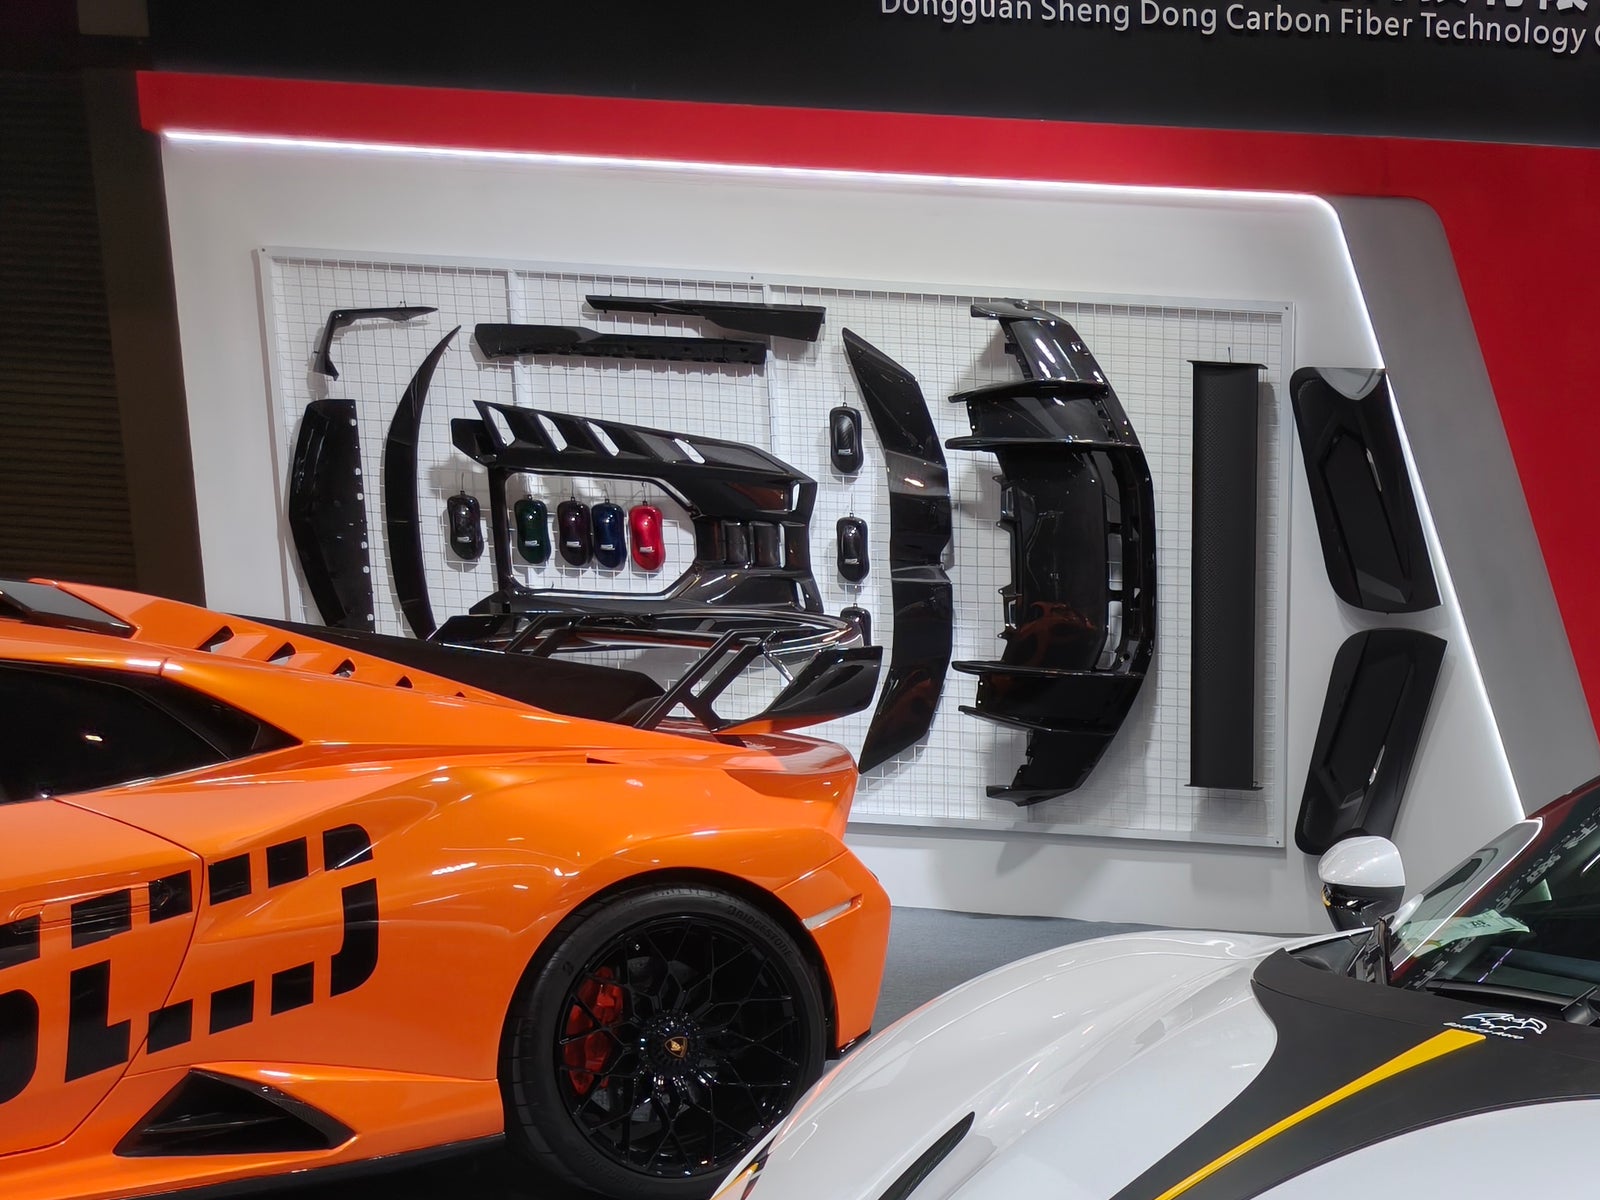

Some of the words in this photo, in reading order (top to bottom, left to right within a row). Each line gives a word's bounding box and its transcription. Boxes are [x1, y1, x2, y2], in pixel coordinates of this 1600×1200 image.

[1041, 0, 1131, 32] Sheng
[1141, 1, 1218, 35] Dong
[1226, 3, 1330, 33] Carbon
[1340, 8, 1413, 37] Fiber
[1420, 12, 1587, 55] Technology
